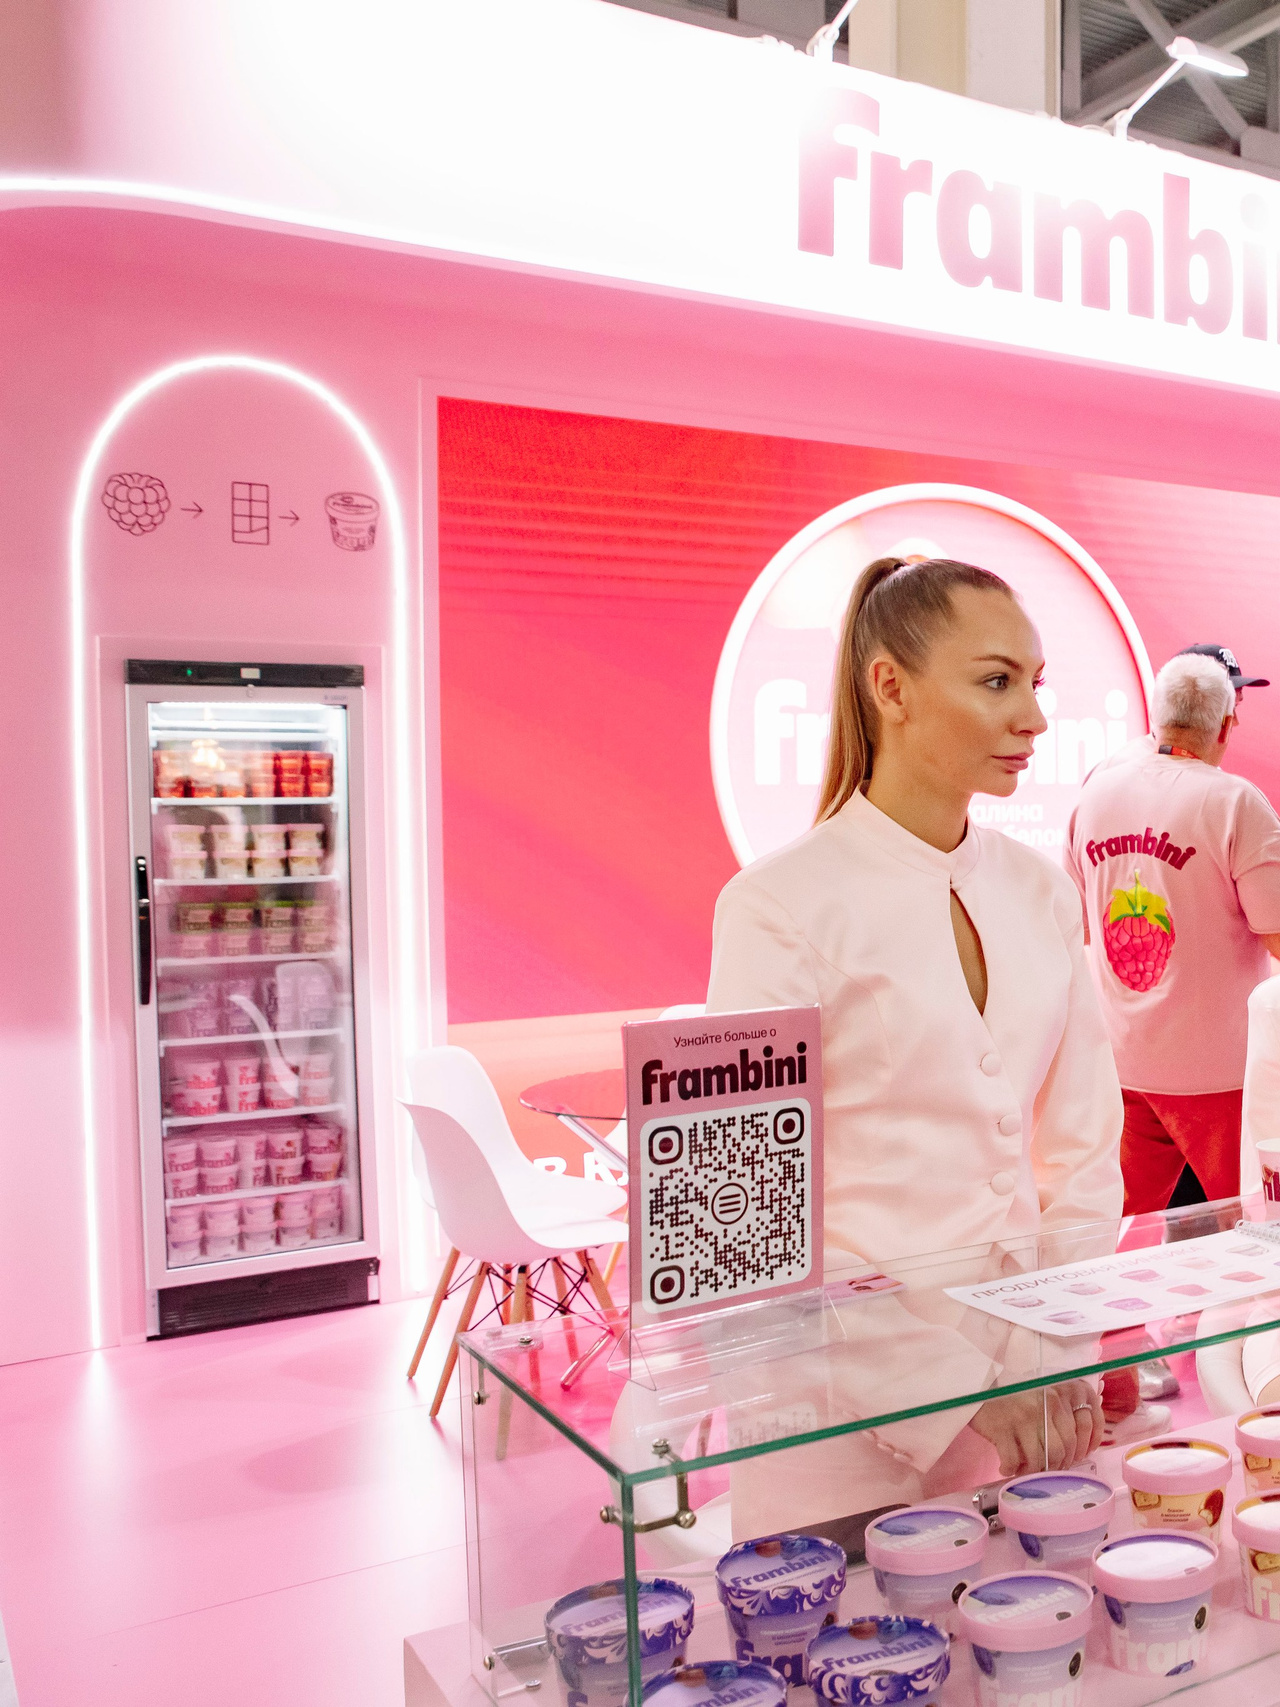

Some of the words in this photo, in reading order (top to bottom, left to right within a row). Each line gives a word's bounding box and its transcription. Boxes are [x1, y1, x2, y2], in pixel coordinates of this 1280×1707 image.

[754, 678, 1128, 788] frini
[1086, 827, 1197, 871] frambini
[673, 1033, 722, 1048] Узнайте
[724, 1029, 766, 1043] больше
[769, 1029, 777, 1038] о
[641, 1041, 807, 1105] frambini
[971, 1262, 1116, 1299] ПРОДУКТОВАЯ
[731, 1551, 832, 1588] frambini
[821, 1635, 933, 1671] frambini
